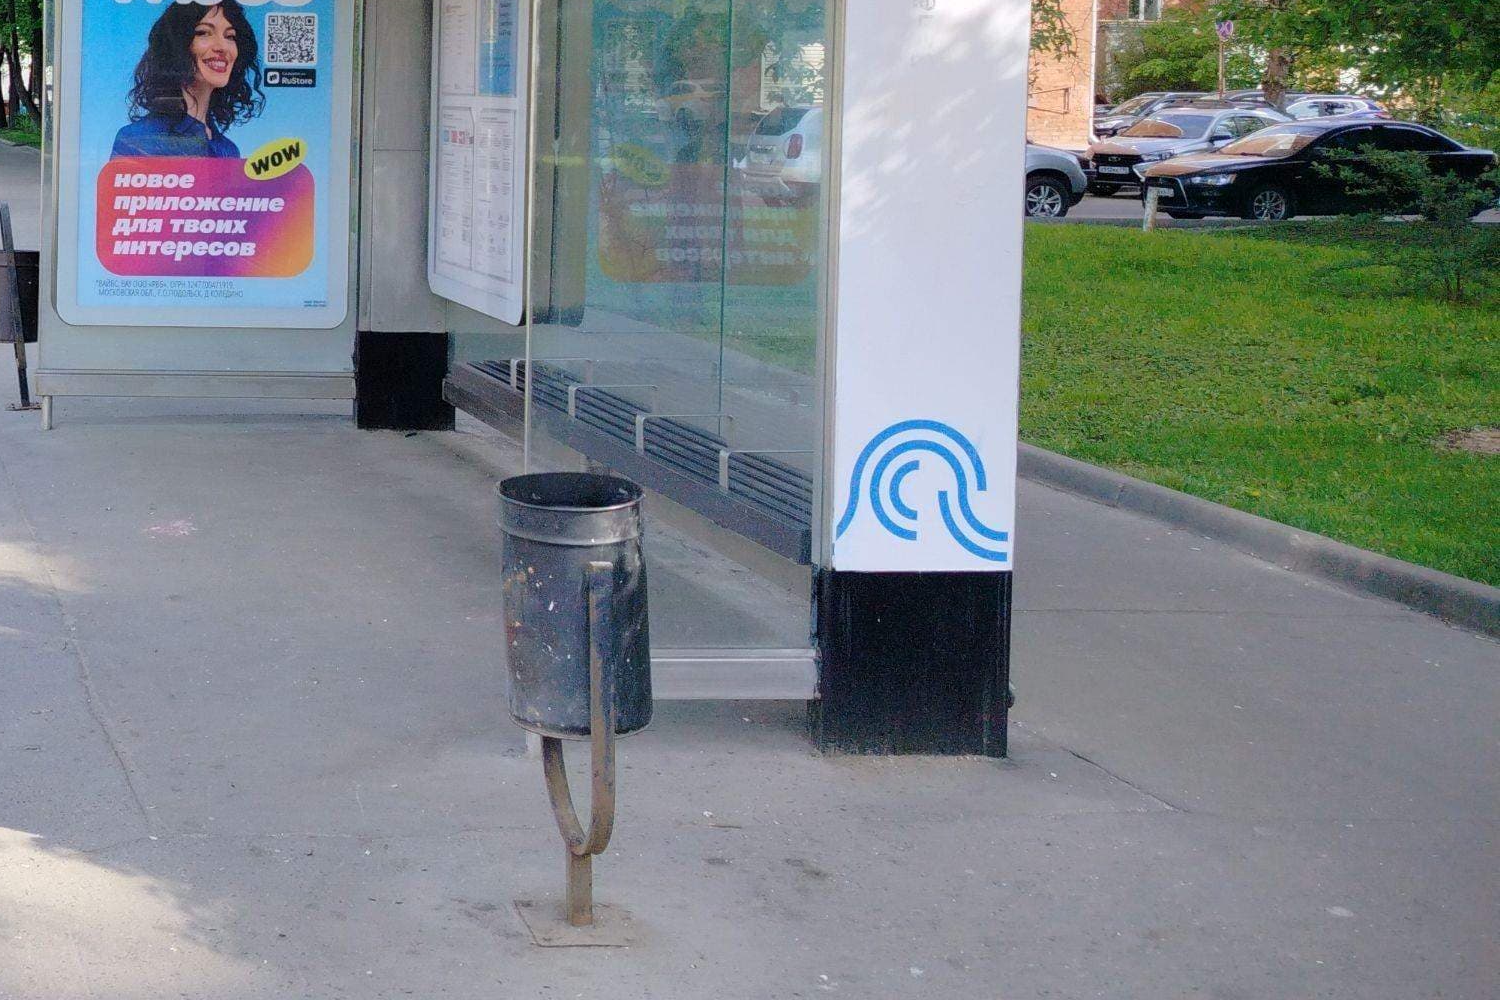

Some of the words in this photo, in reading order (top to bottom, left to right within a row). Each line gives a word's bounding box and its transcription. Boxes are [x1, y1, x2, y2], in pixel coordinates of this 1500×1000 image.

[281, 77, 314, 86] RuStore
[113, 172, 195, 189] новое
[113, 195, 286, 216] приложение
[111, 218, 164, 236] для
[169, 219, 248, 235] твоих
[112, 240, 256, 262] интересов
